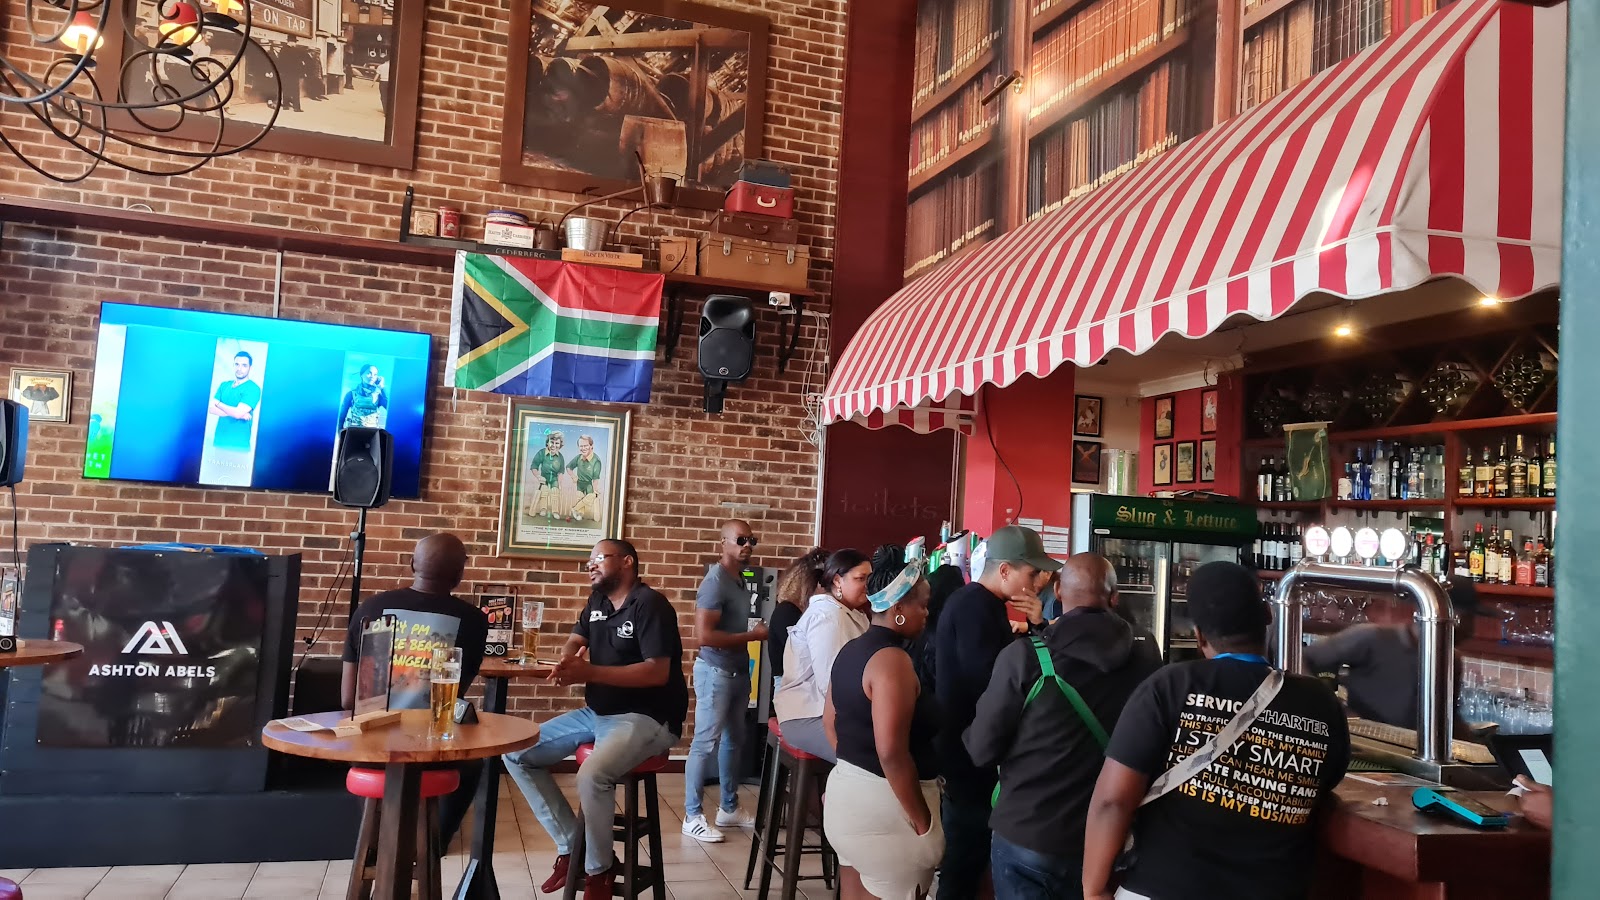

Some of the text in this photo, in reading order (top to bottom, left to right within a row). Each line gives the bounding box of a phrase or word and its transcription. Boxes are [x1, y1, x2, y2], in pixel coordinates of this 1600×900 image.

[263, 8, 279, 26] ON
[286, 15, 306, 32] TAP
[495, 247, 547, 259] CEDERBERG
[1115, 505, 1238, 529] Slug & Lettuce
[410, 623, 431, 636] PM
[88, 664, 216, 678] ASHTON ABELS
[1185, 693, 1243, 714] SERVIC
[1180, 711, 1194, 720] NO
[1196, 714, 1229, 726] TRAFFIC
[1251, 726, 1266, 737] ON
[1267, 730, 1283, 741] THE
[1285, 735, 1328, 751] EXTRA-MILE
[1180, 719, 1201, 730] THIS
[1203, 723, 1213, 731] IS
[1240, 732, 1277, 749] EMBER,
[1279, 741, 1295, 752] MY
[1296, 746, 1327, 759] FAMILY
[1174, 727, 1324, 777] I STY SMART
[1219, 754, 1242, 769] CAN
[1244, 763, 1275, 779] HEAR
[1277, 770, 1295, 782] ME
[1178, 782, 1198, 797] IS
[1201, 789, 1216, 803] IS
[1220, 795, 1246, 813] MY
[1189, 777, 1235, 798] ALWAYS
[1236, 792, 1260, 805] KEEP
[1262, 800, 1279, 811] MY
[1201, 771, 1229, 788] FULL
[1232, 782, 1313, 807] ACCOUNTABILIT
[1232, 769, 1287, 794] RAVING
[1290, 784, 1318, 798] FANS
